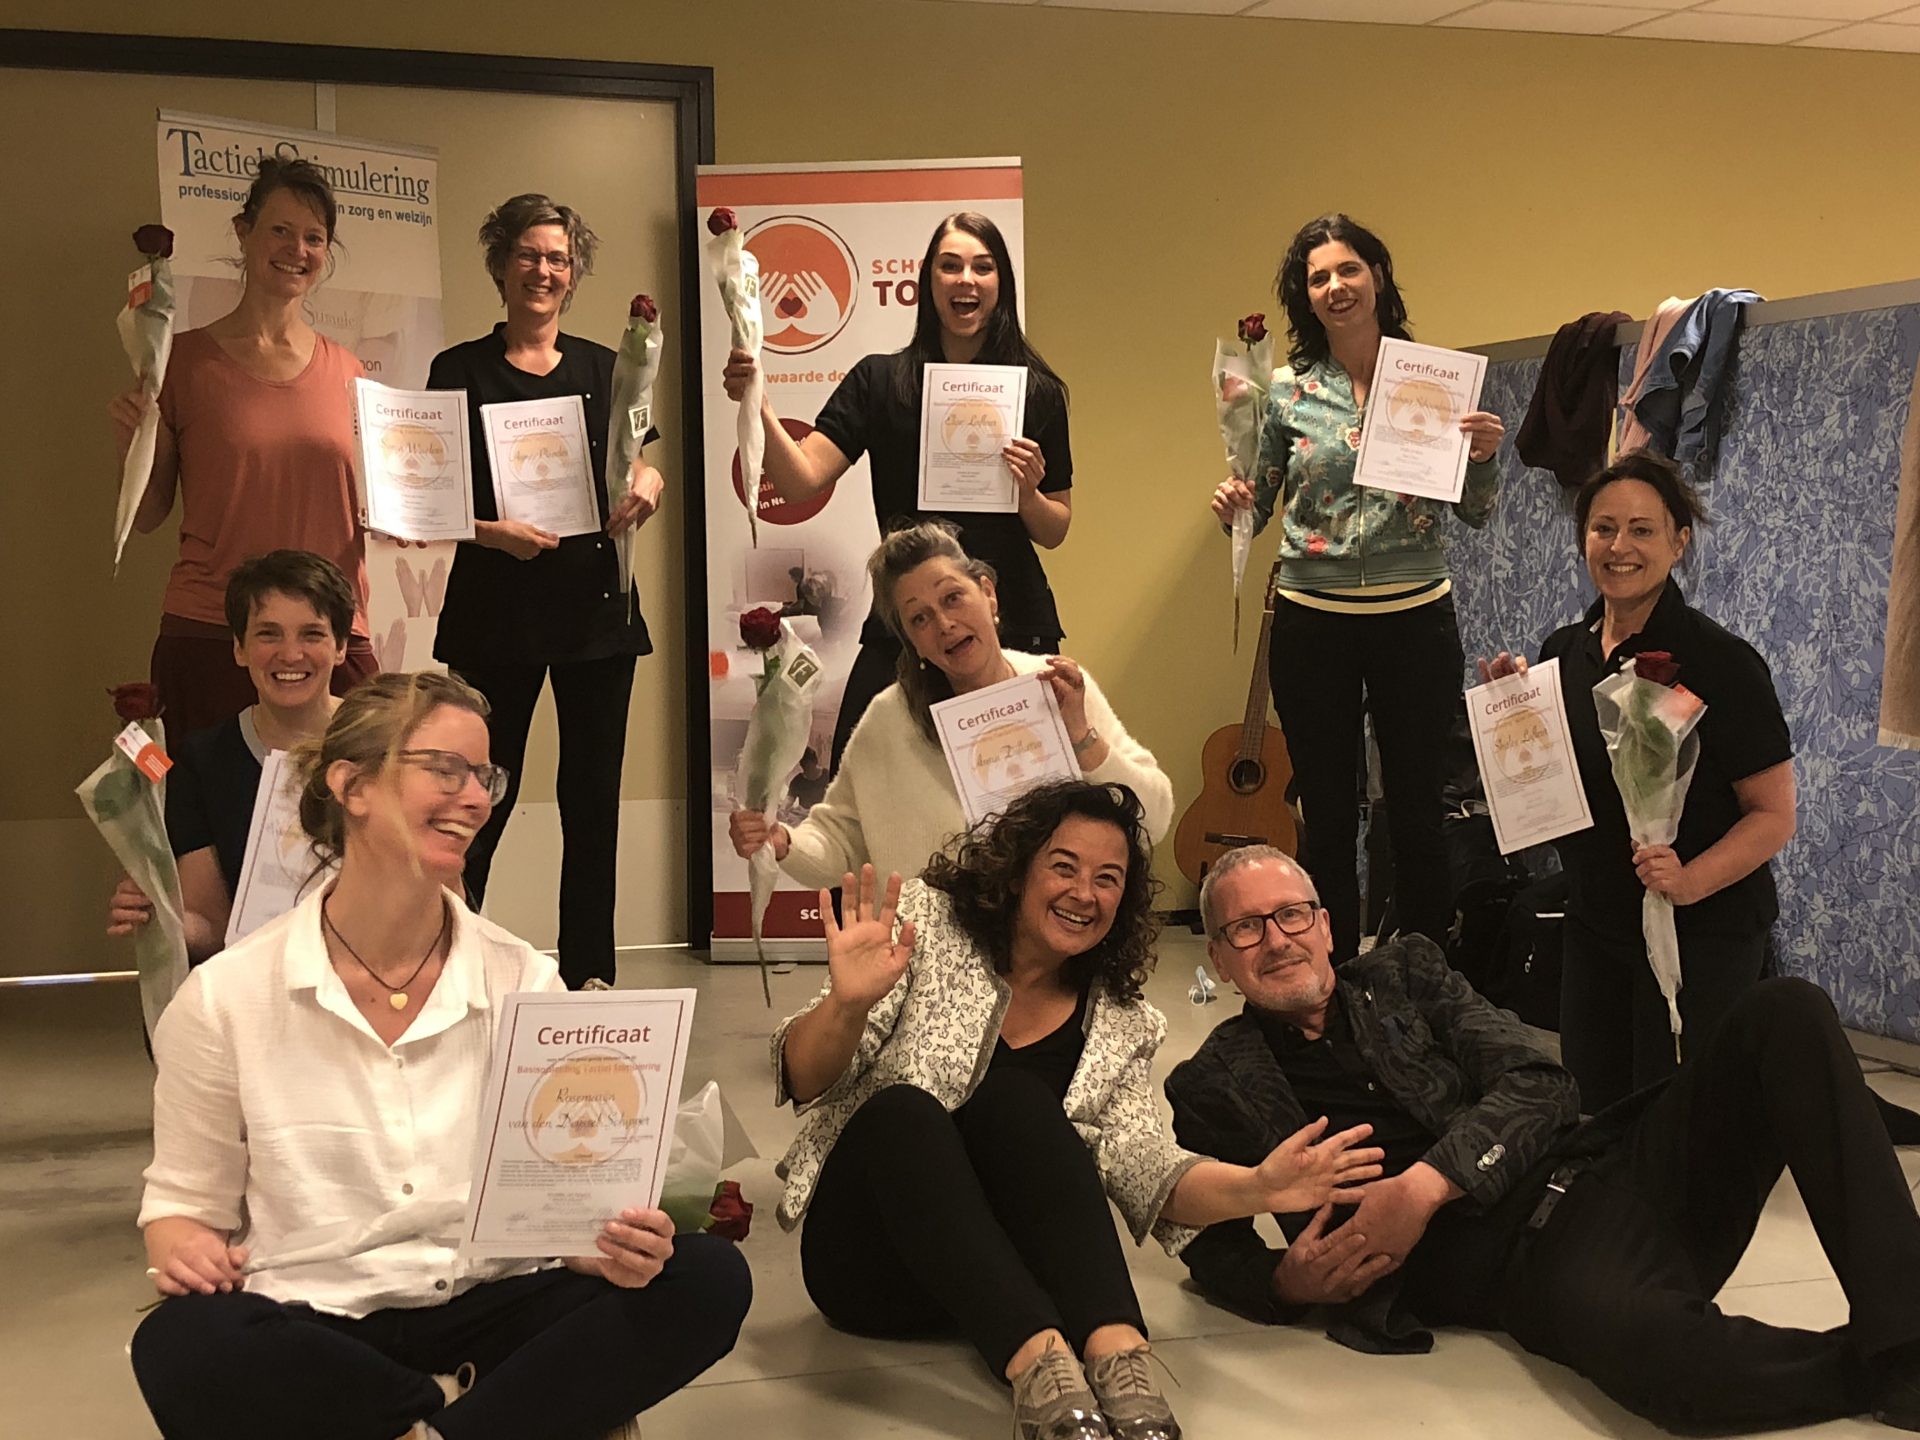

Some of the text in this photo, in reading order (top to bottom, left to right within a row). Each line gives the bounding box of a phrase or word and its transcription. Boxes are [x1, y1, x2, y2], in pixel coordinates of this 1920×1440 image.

[275, 142, 430, 205] Smulering
[348, 205, 374, 221] zorg
[378, 208, 392, 220] en
[395, 210, 433, 227] welzijn
[1395, 359, 1460, 381] Certificaat
[942, 381, 1004, 393] Certificaat
[375, 403, 443, 421] Certificaat
[503, 415, 564, 430] Certificaat
[1485, 687, 1541, 715] Certificaat
[957, 699, 1030, 731] Certificaat
[537, 1025, 651, 1046] Certificaat
